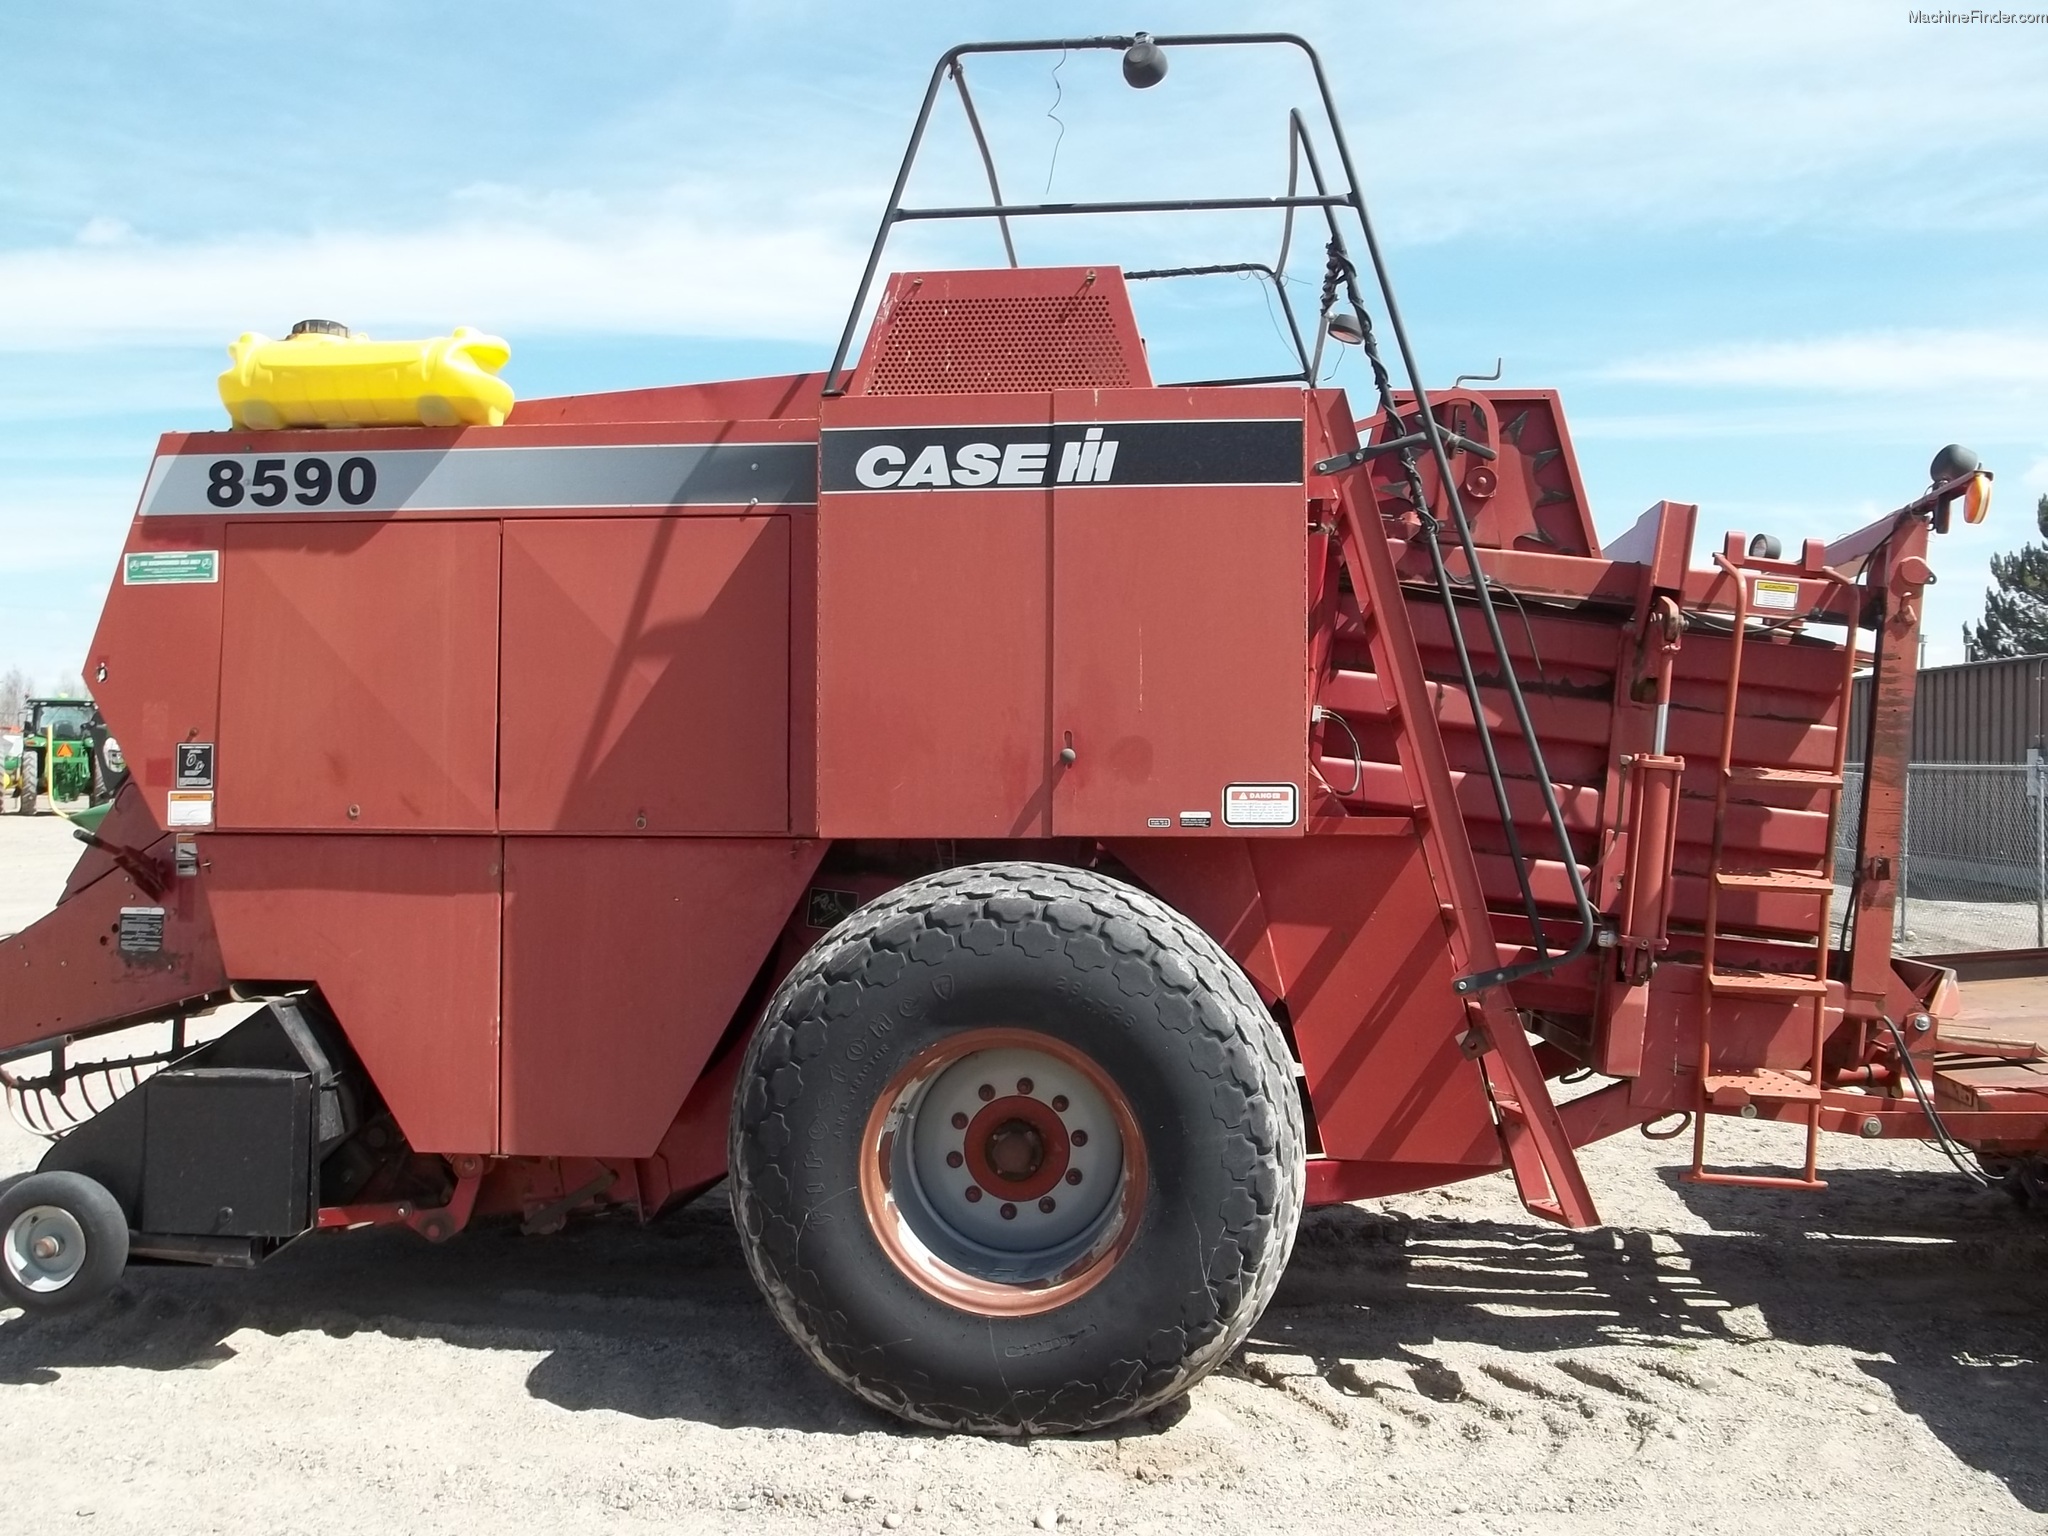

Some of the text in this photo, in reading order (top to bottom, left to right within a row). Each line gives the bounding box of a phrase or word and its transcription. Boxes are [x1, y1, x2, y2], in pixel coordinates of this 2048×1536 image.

[206, 456, 377, 508] 8590
[855, 443, 1051, 489] CASE
[1249, 792, 1281, 800] DANGER
